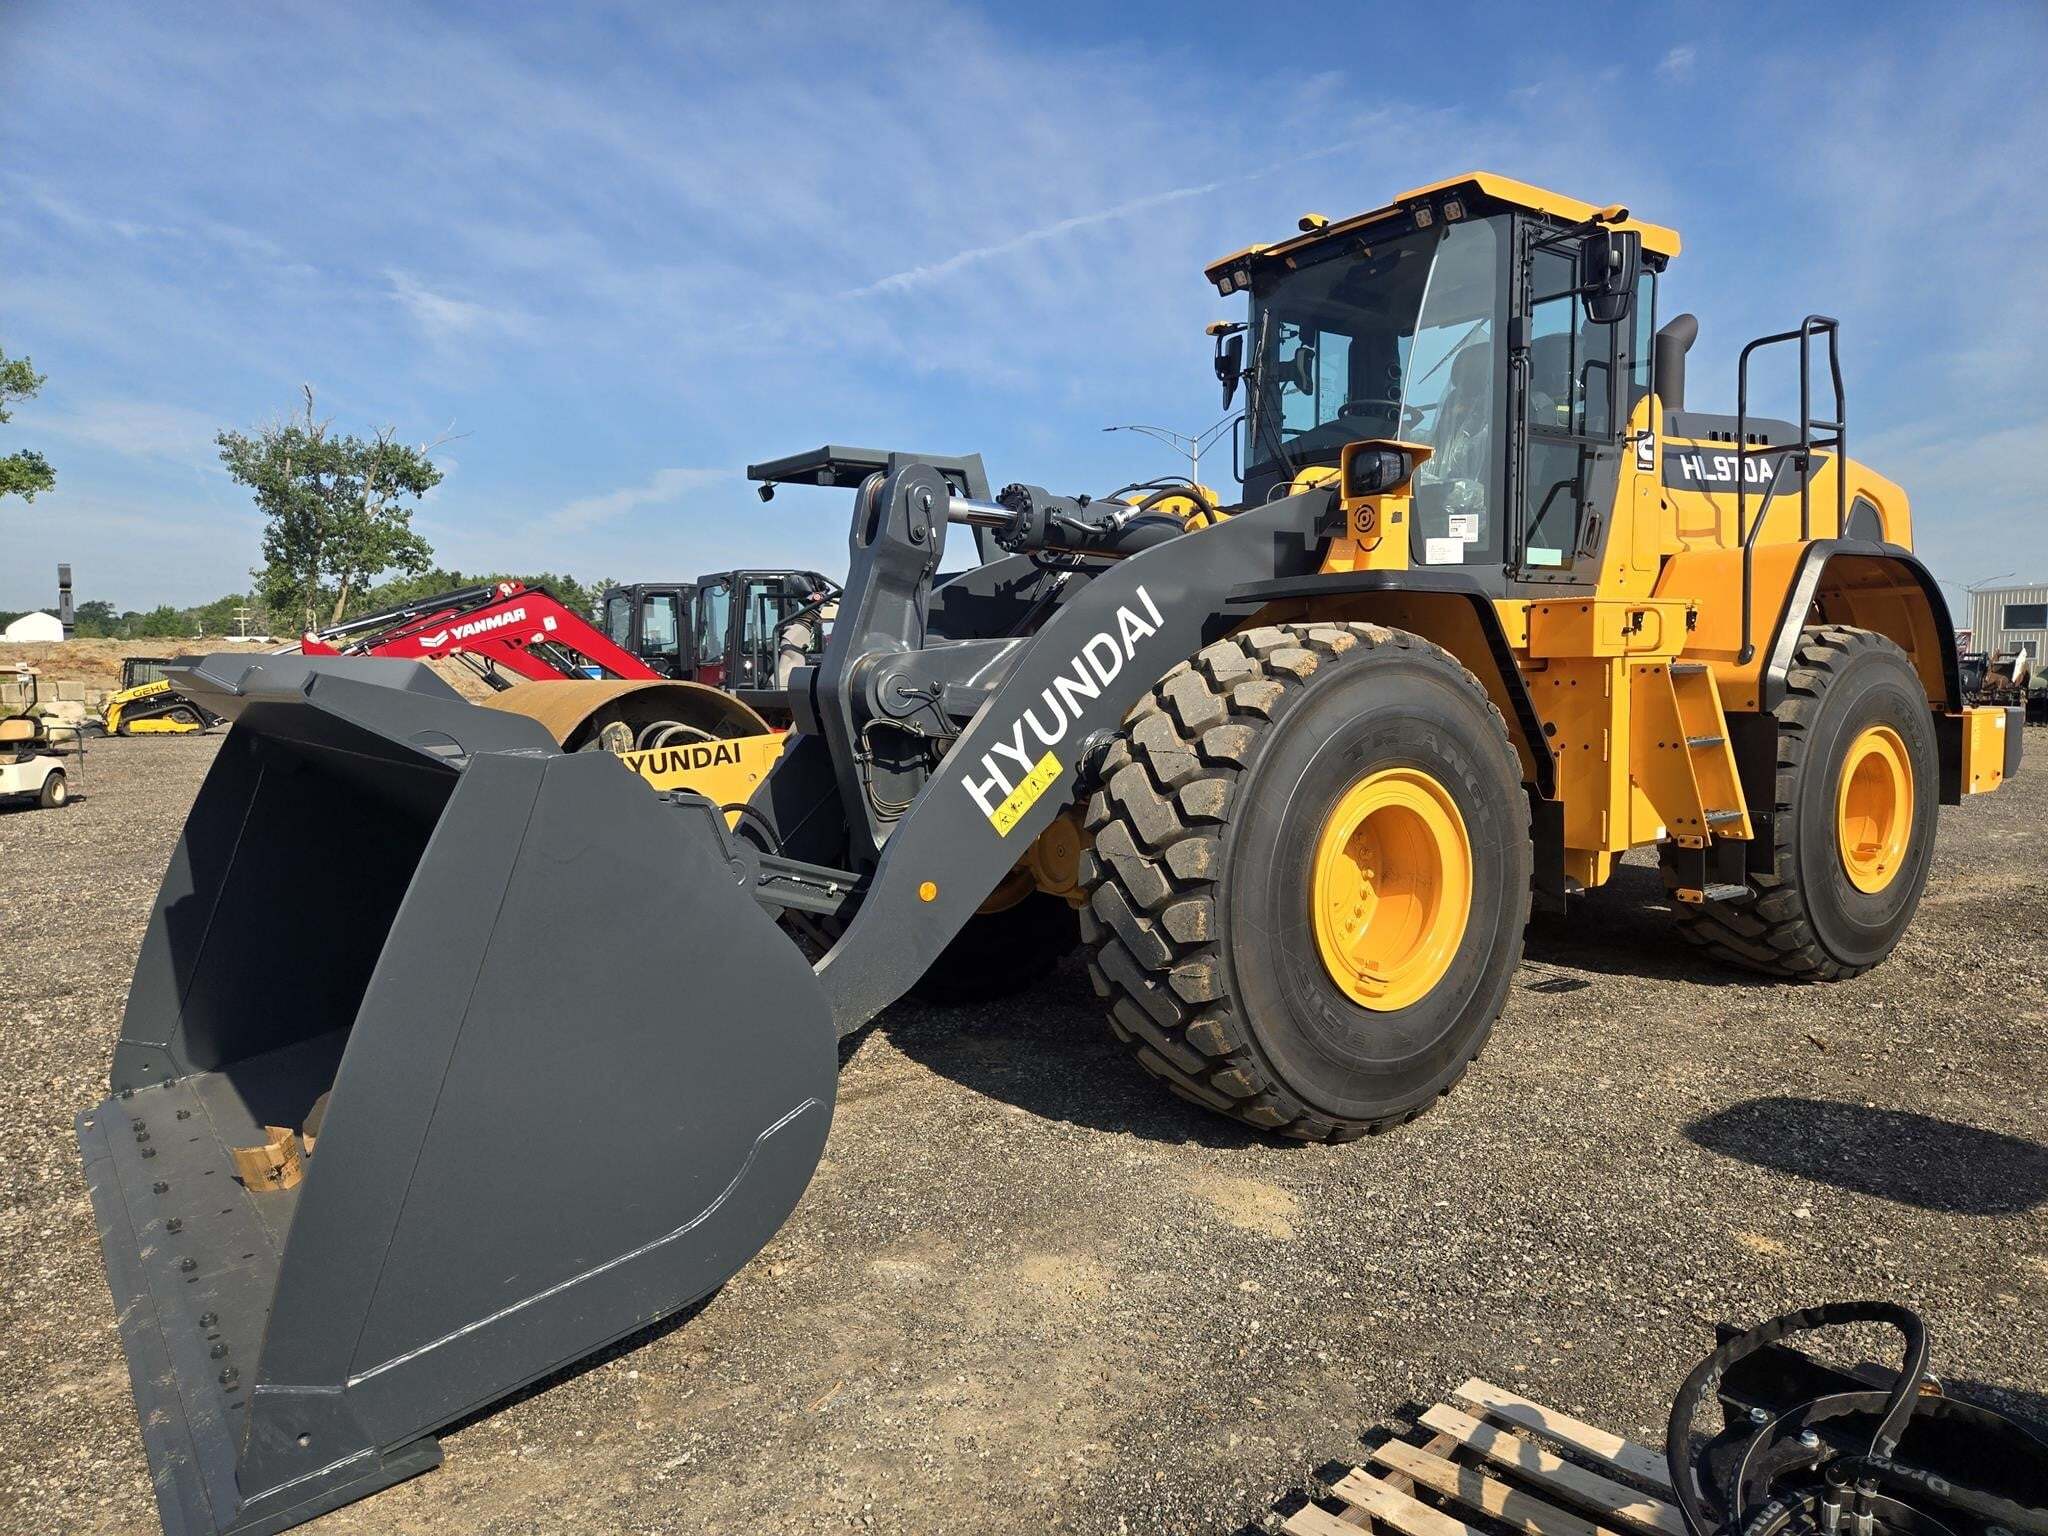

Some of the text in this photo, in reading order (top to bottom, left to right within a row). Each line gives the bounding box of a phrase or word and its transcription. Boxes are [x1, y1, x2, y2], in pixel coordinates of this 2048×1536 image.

[1680, 454, 1774, 483] HL970A
[450, 607, 527, 640] YANMAR
[132, 684, 167, 697] GEHL
[961, 585, 1165, 818] HYUNDAI
[626, 743, 741, 775] YUNDAI
